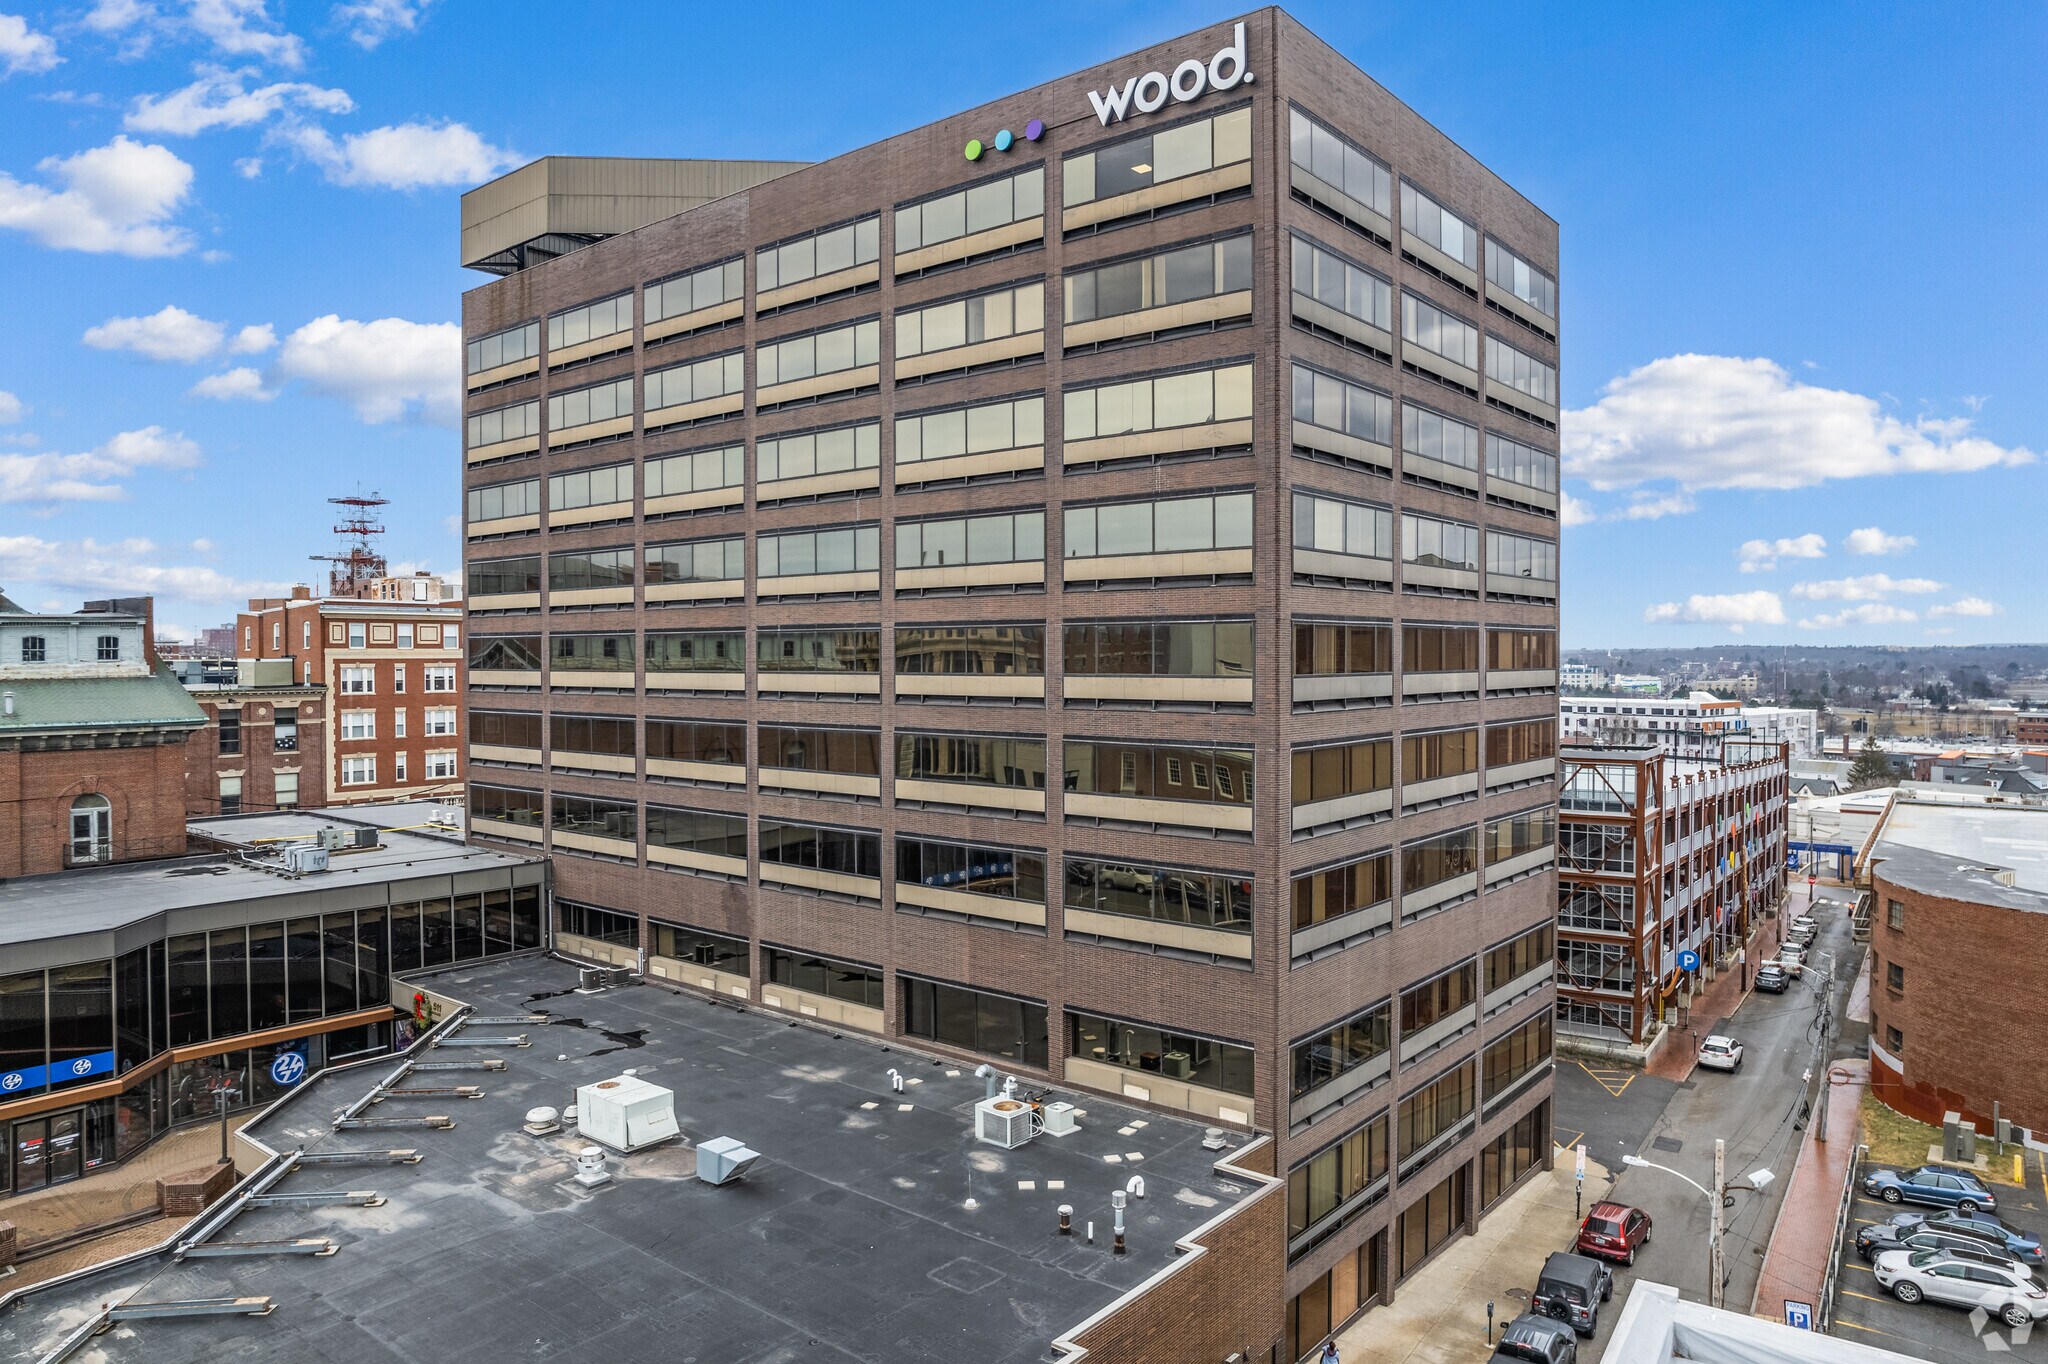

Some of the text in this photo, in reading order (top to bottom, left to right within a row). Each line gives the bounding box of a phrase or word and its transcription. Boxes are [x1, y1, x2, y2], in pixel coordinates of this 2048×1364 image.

[1087, 21, 1254, 126] wood.
[1684, 954, 1694, 966] P
[433, 1002, 441, 1013] 511
[276, 1055, 303, 1073] 24
[280, 1069, 293, 1082] 7
[1794, 1312, 1804, 1327] P
